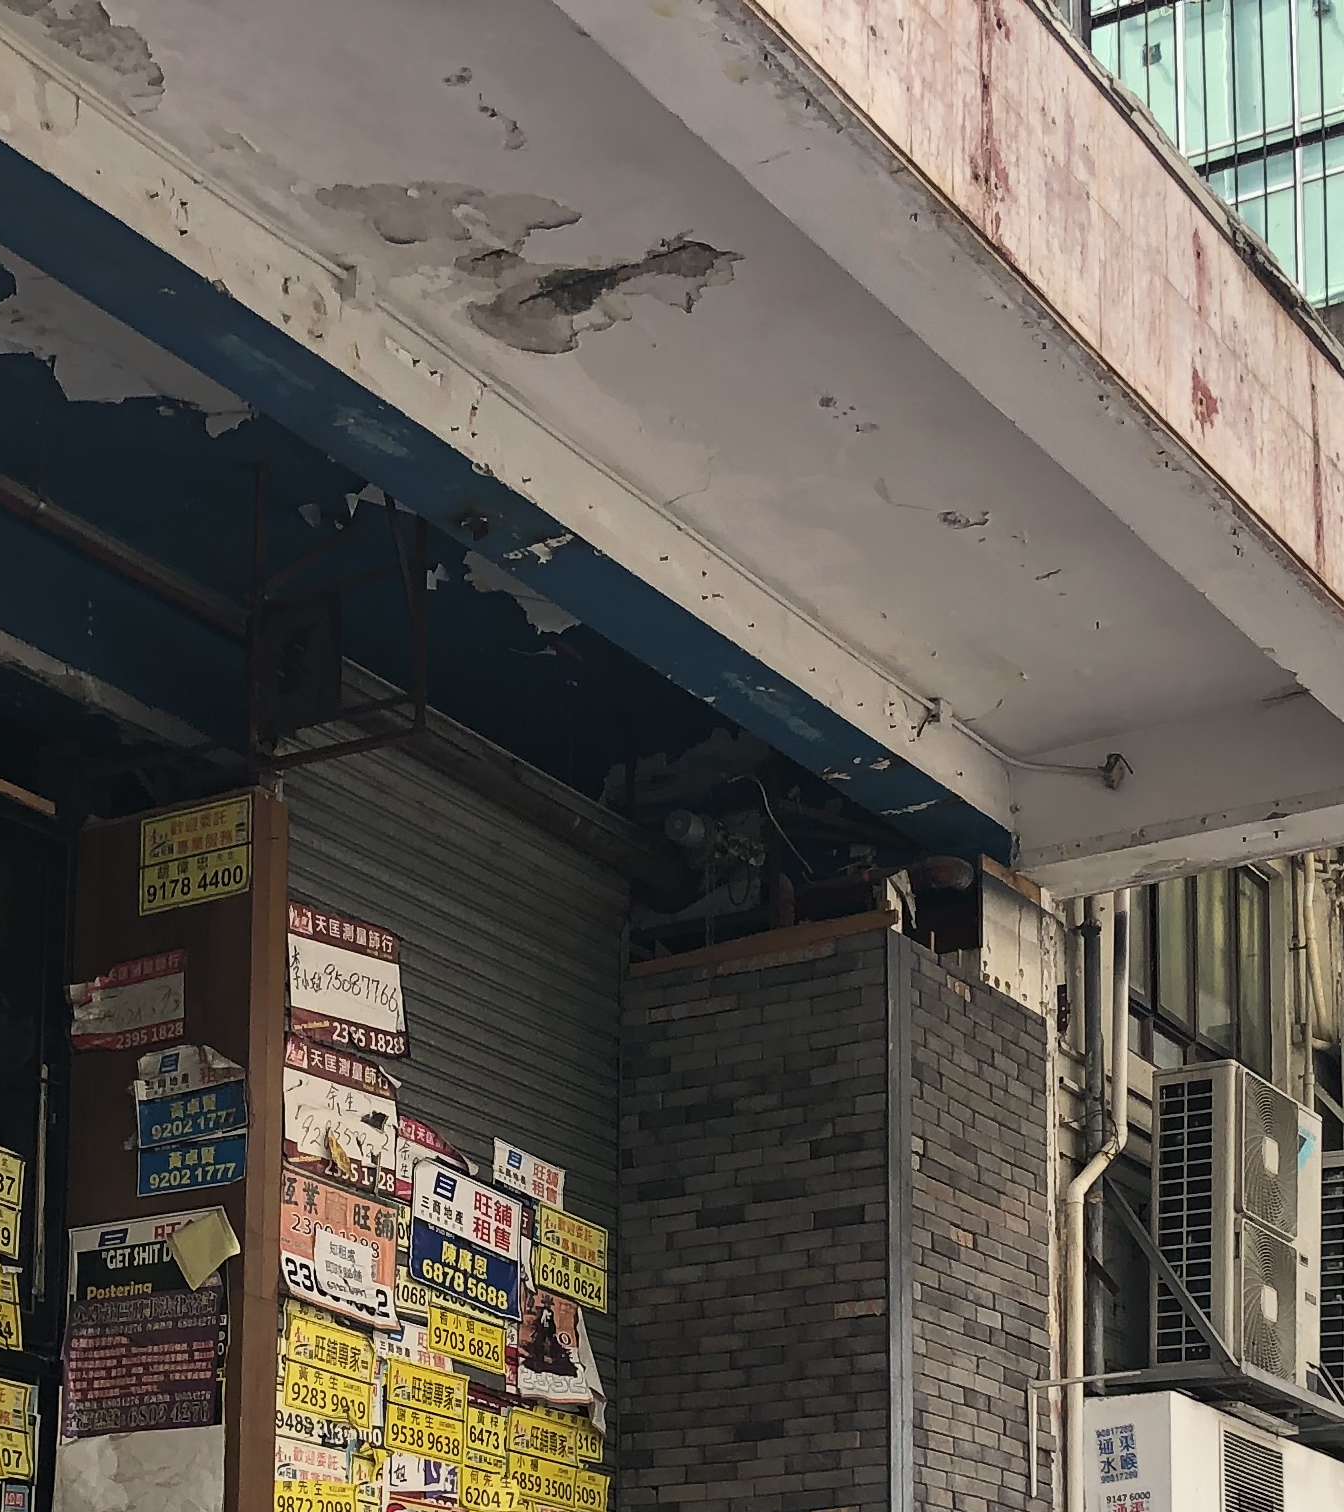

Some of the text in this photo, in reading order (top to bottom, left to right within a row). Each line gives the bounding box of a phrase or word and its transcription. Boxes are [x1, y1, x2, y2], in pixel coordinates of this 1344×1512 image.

[146, 864, 244, 904] 9178 4400
[115, 1020, 184, 1051] 2395 1828
[149, 1161, 236, 1189] 9202 1777
[474, 1191, 513, 1228] 旺舖
[472, 1217, 511, 1253] 租售
[101, 1245, 161, 1270] "GET SHIT
[422, 1259, 508, 1310] 6878 5688
[541, 1264, 602, 1303] 6108 0624
[434, 1327, 500, 1363] 9703 6826
[291, 1382, 327, 1410] 9283
[391, 1422, 460, 1457] 9538 9638
[469, 1425, 500, 1450] 6473
[465, 1485, 501, 1508] 6204
[544, 1478, 573, 1501] 3500
[1106, 1491, 1151, 1504] 9147 6000
